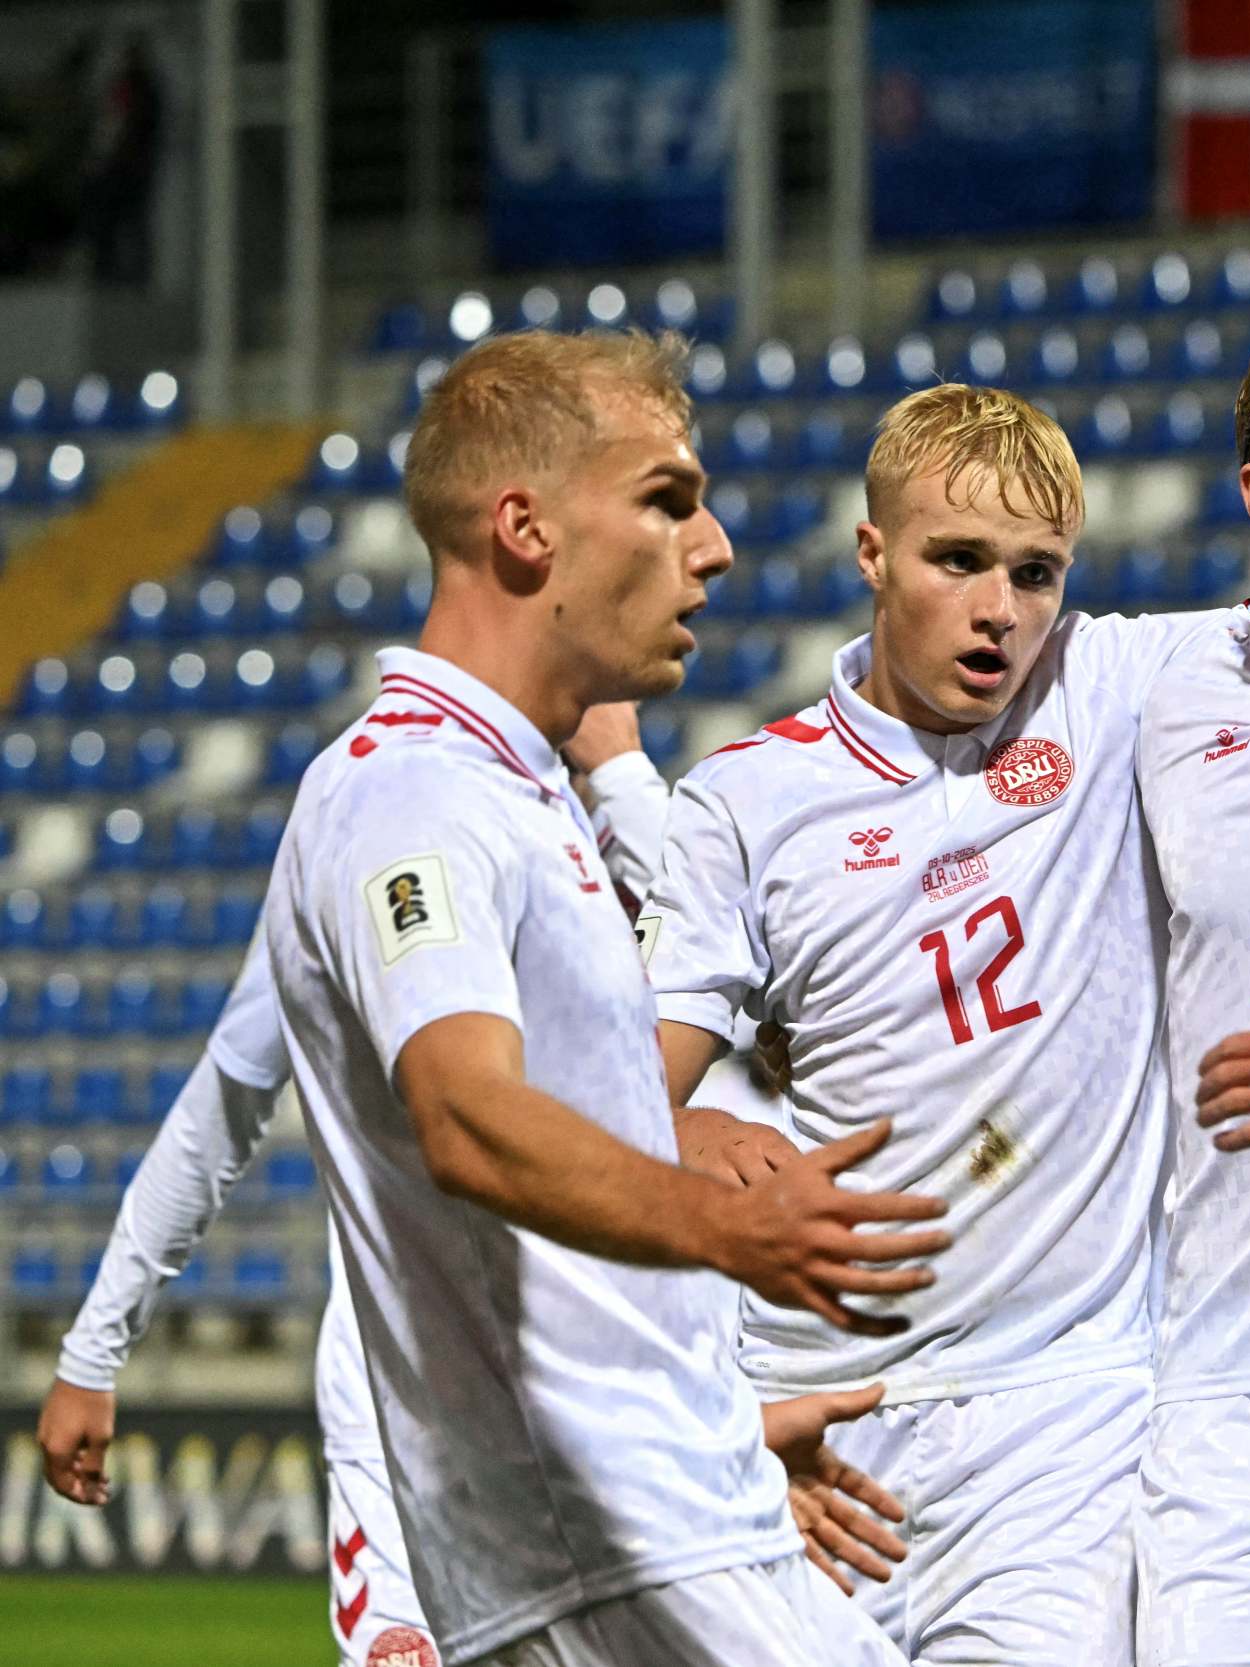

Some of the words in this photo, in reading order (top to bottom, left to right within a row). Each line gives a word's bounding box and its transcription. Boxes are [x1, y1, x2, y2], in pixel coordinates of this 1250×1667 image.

[1204, 739, 1250, 763] hummel
[1001, 754, 1056, 790] DBU
[1026, 786, 1060, 804] 1889
[844, 853, 900, 872] hummel
[922, 867, 948, 892] BLR
[958, 854, 989, 879] DEN
[919, 895, 1042, 1045] 12
